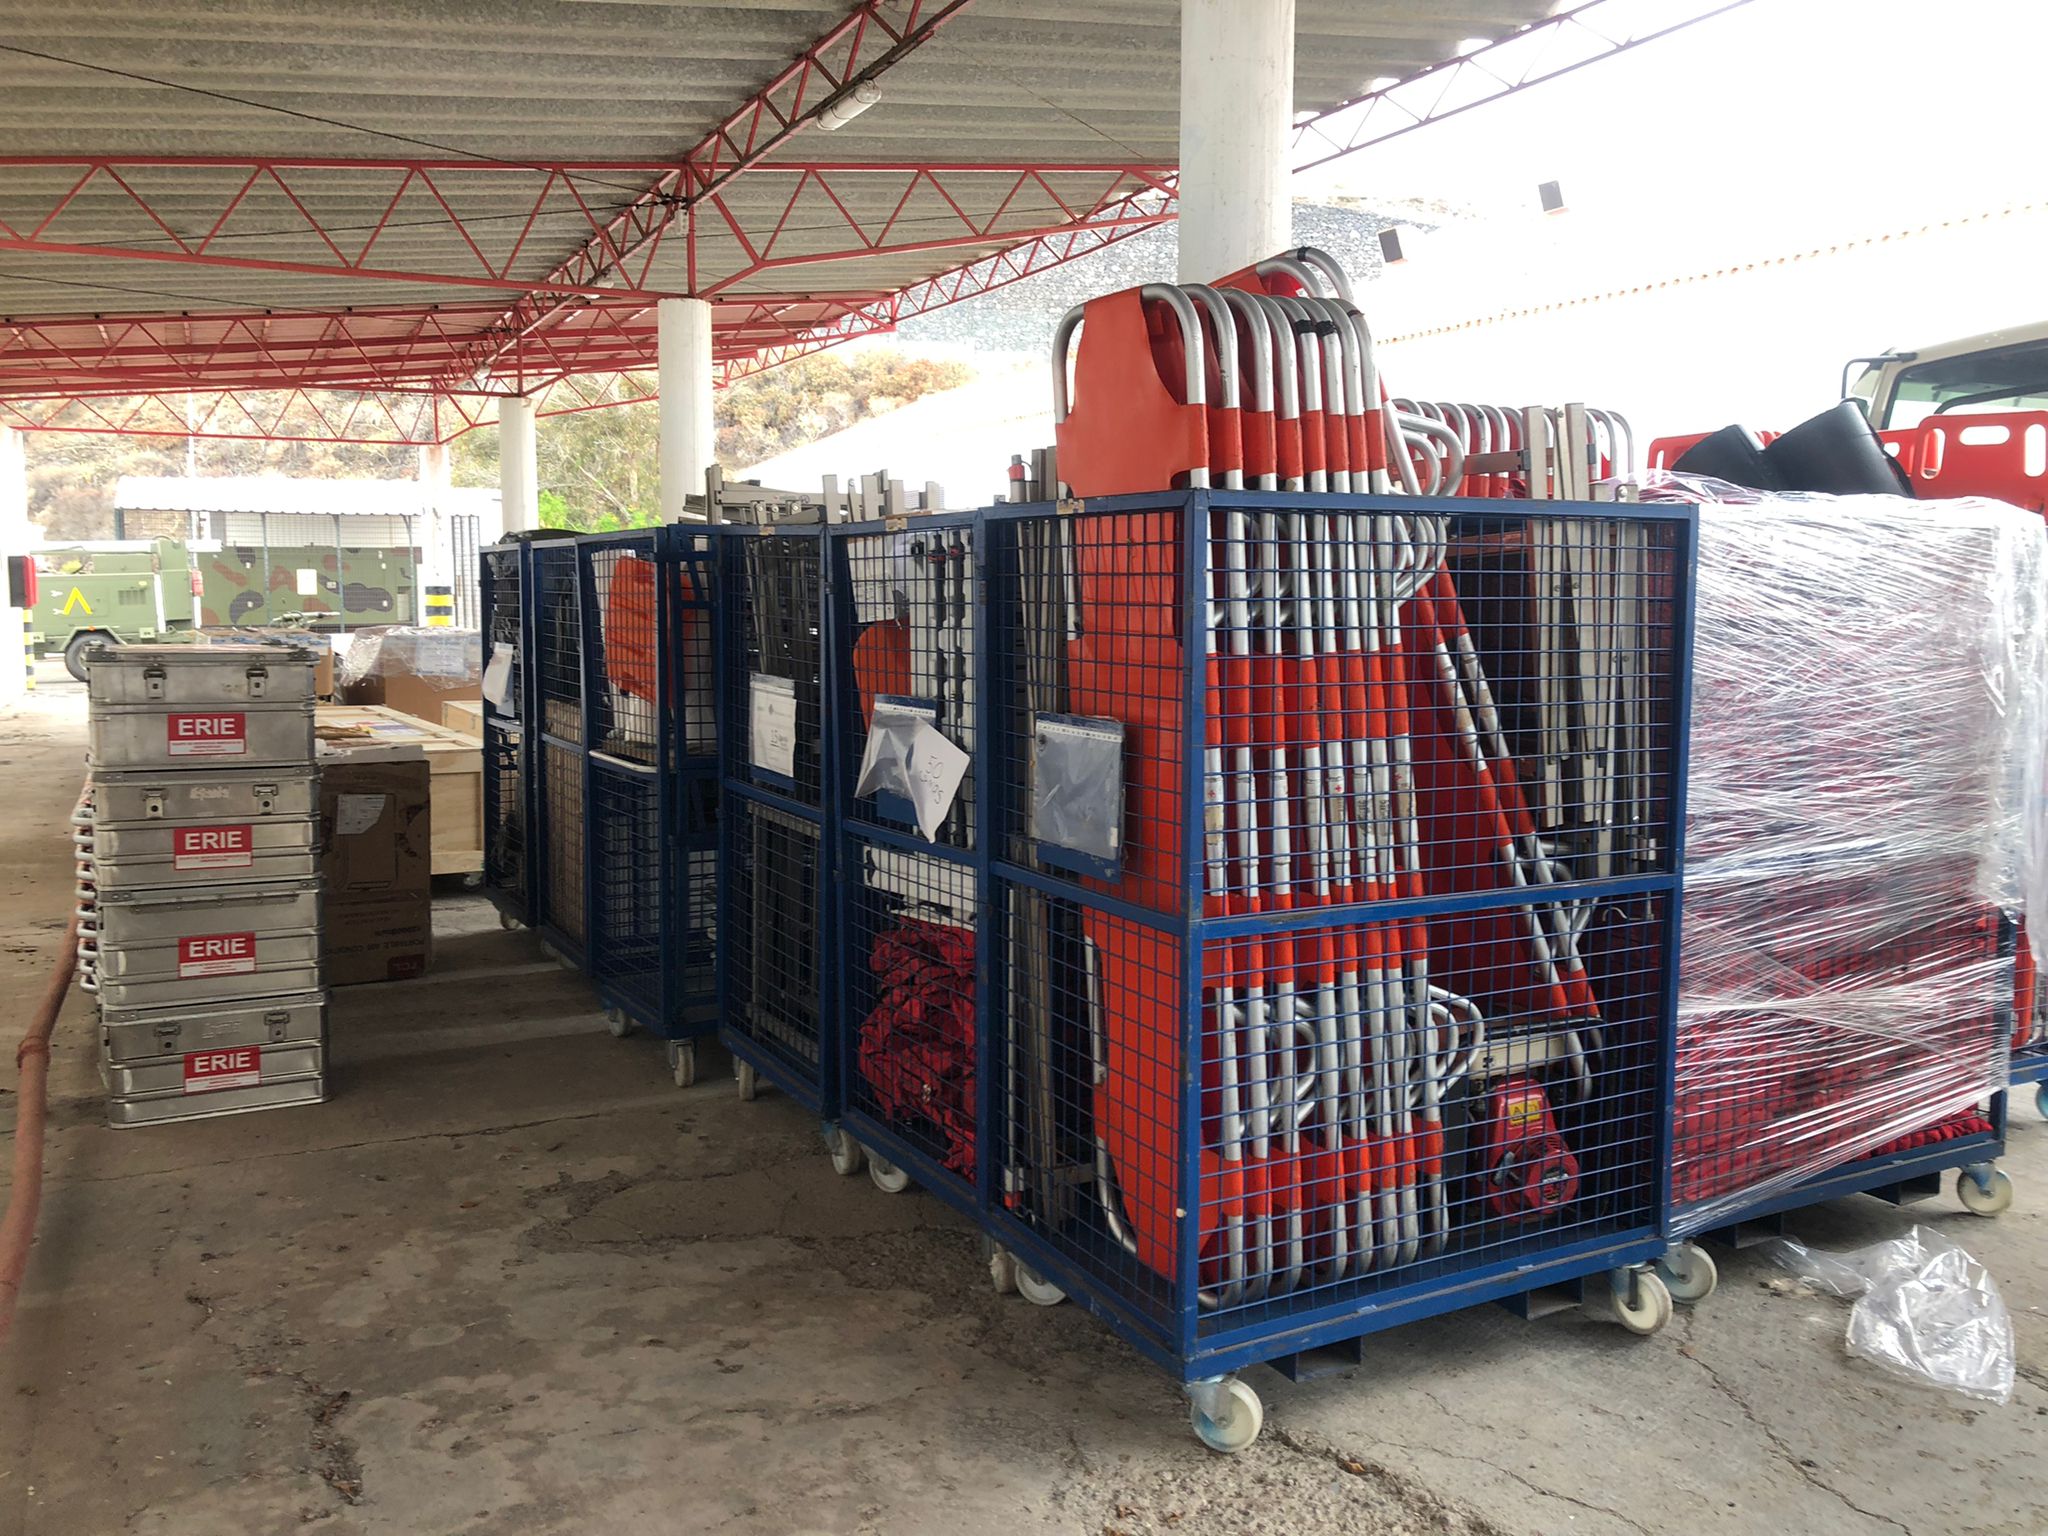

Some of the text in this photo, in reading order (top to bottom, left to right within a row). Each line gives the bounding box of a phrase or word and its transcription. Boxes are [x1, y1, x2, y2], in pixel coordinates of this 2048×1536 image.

[177, 718, 236, 736] ERIE
[184, 831, 243, 850] ERIE
[188, 938, 247, 958] ERIE
[194, 1052, 251, 1073] ERIE
